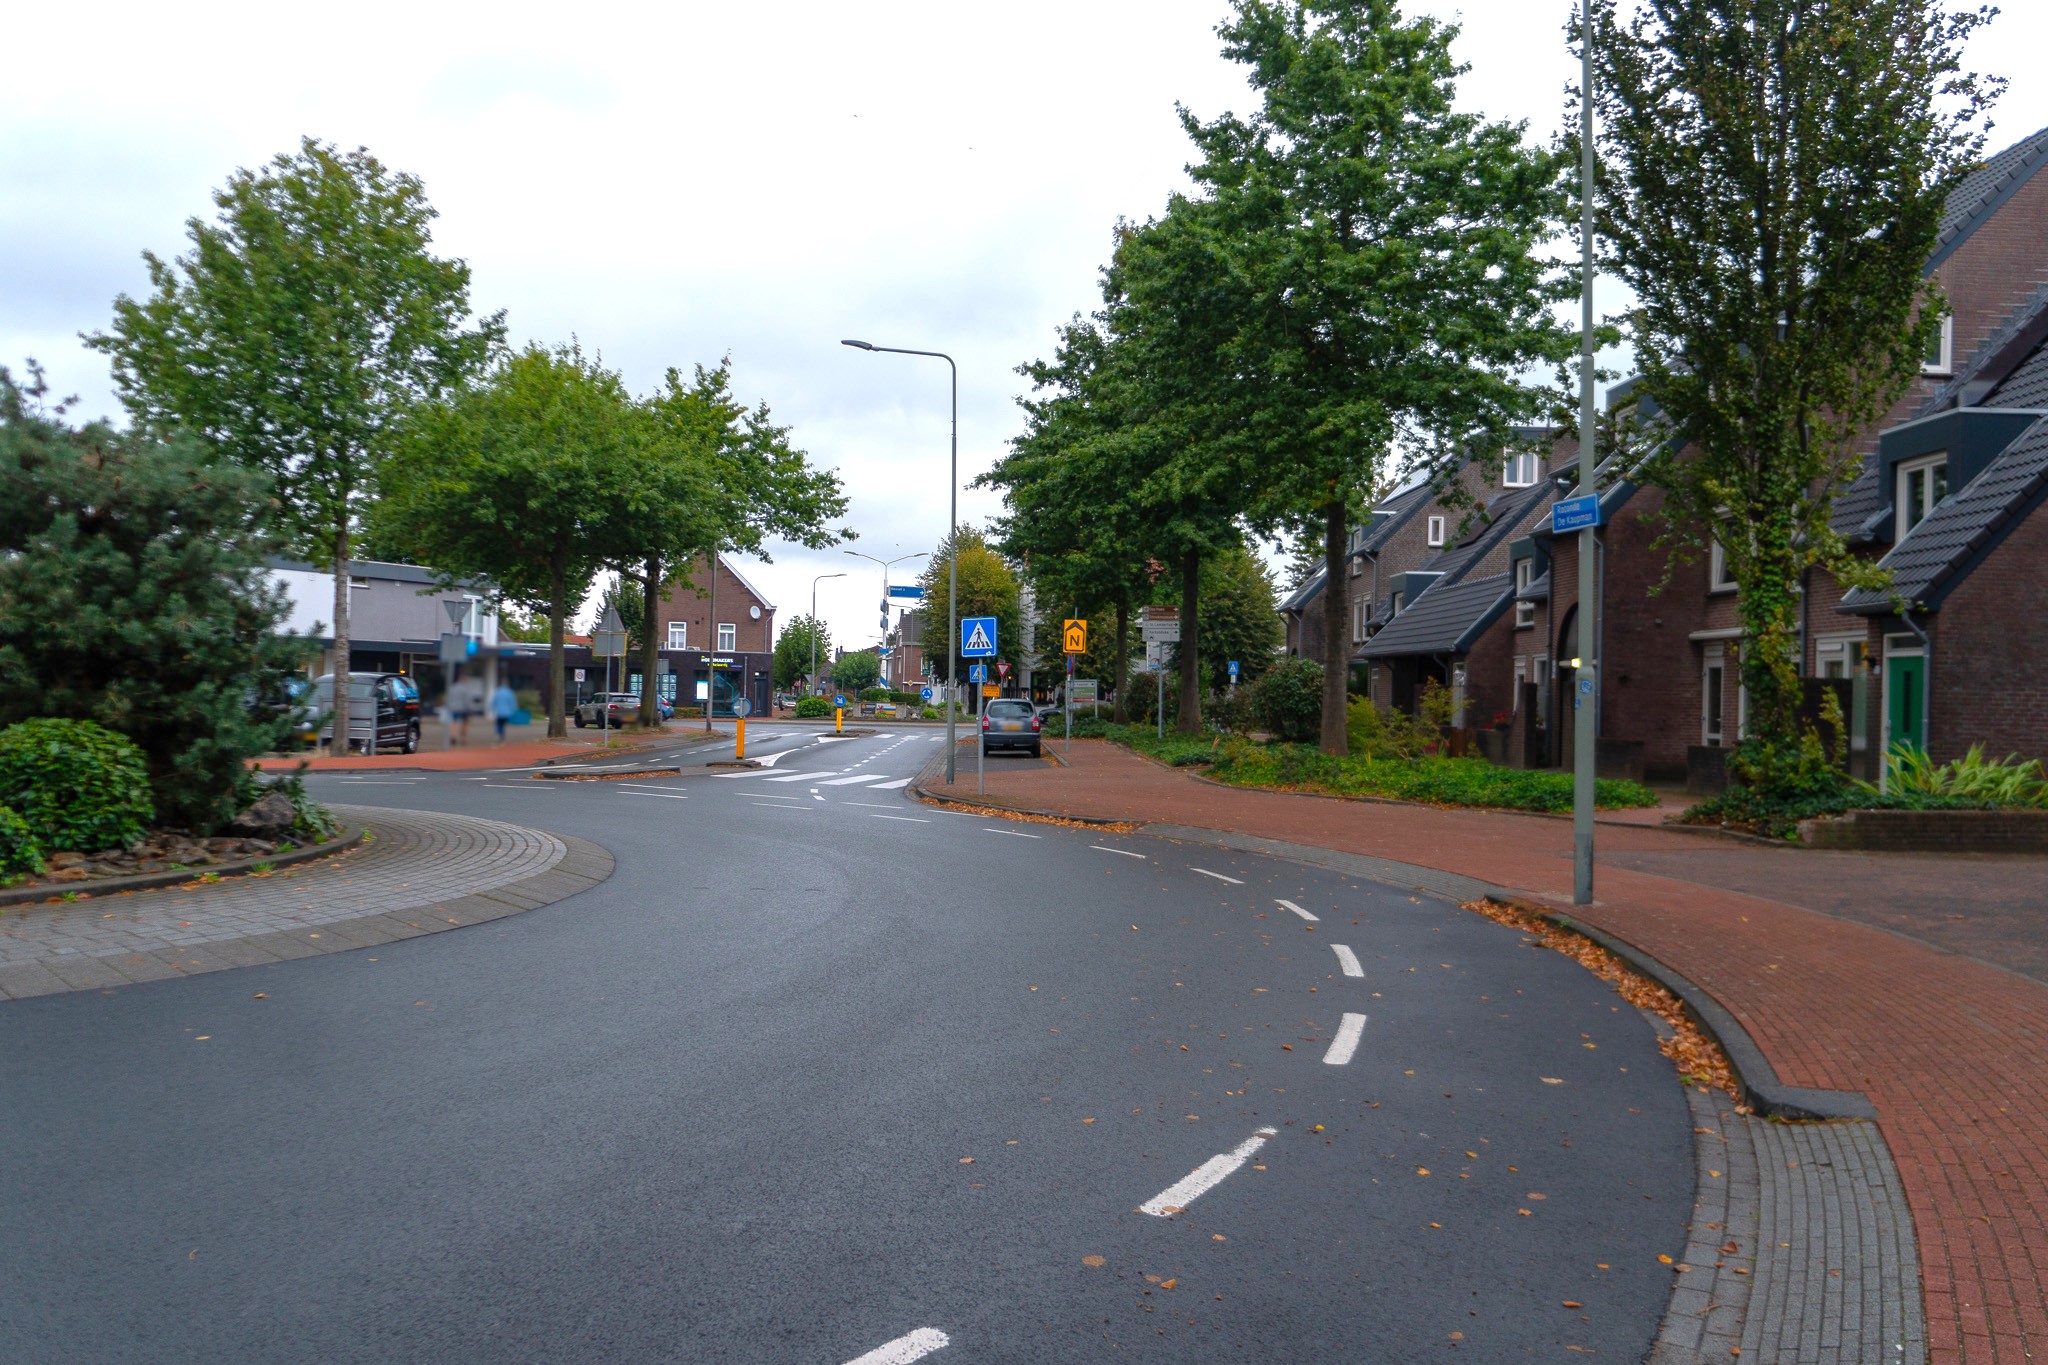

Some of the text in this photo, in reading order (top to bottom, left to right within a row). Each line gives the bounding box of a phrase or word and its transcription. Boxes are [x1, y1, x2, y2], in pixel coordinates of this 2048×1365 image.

[1557, 502, 1580, 513] Rotonde
[1558, 517, 1566, 527] De
[1070, 635, 1080, 646] N
